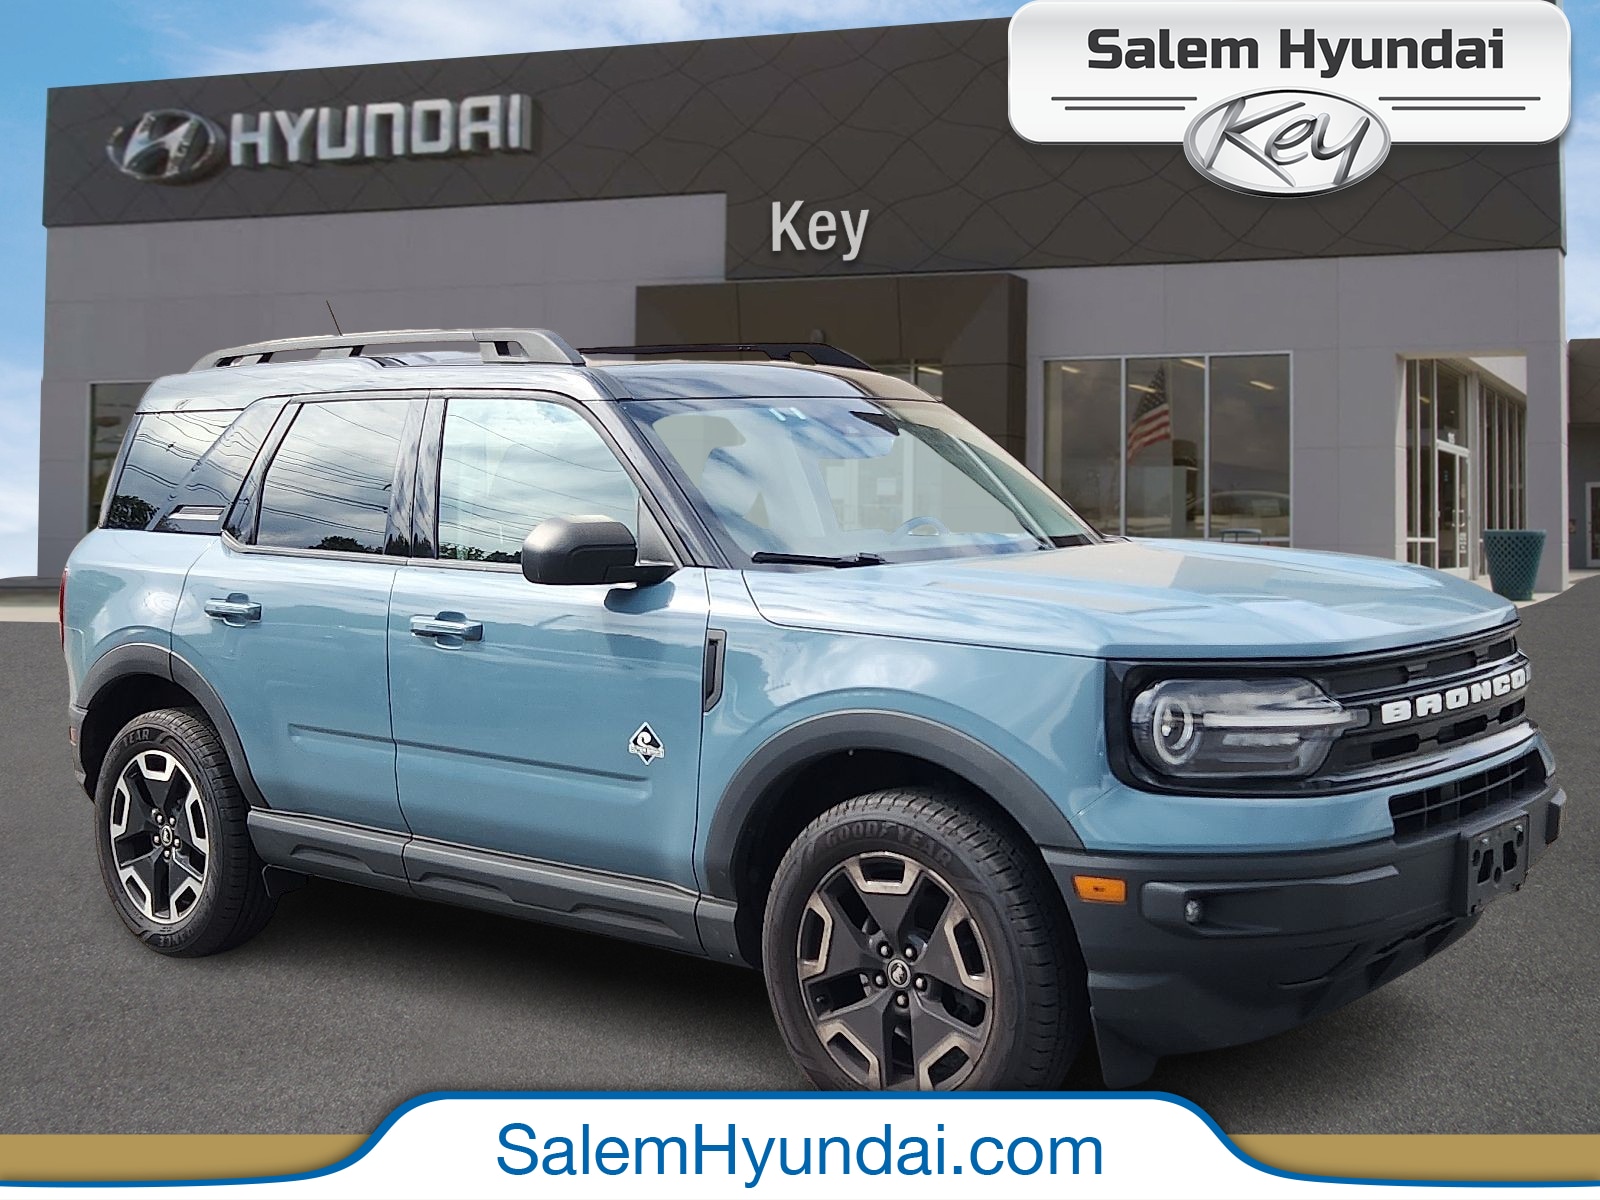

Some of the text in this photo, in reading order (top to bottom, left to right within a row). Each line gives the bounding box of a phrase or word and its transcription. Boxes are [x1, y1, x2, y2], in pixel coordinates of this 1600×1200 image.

[230, 94, 532, 166] HYUNDAI
[771, 199, 870, 262] Key
[1381, 667, 1527, 725] BRONCO
[824, 820, 954, 868] GOODYEAR
